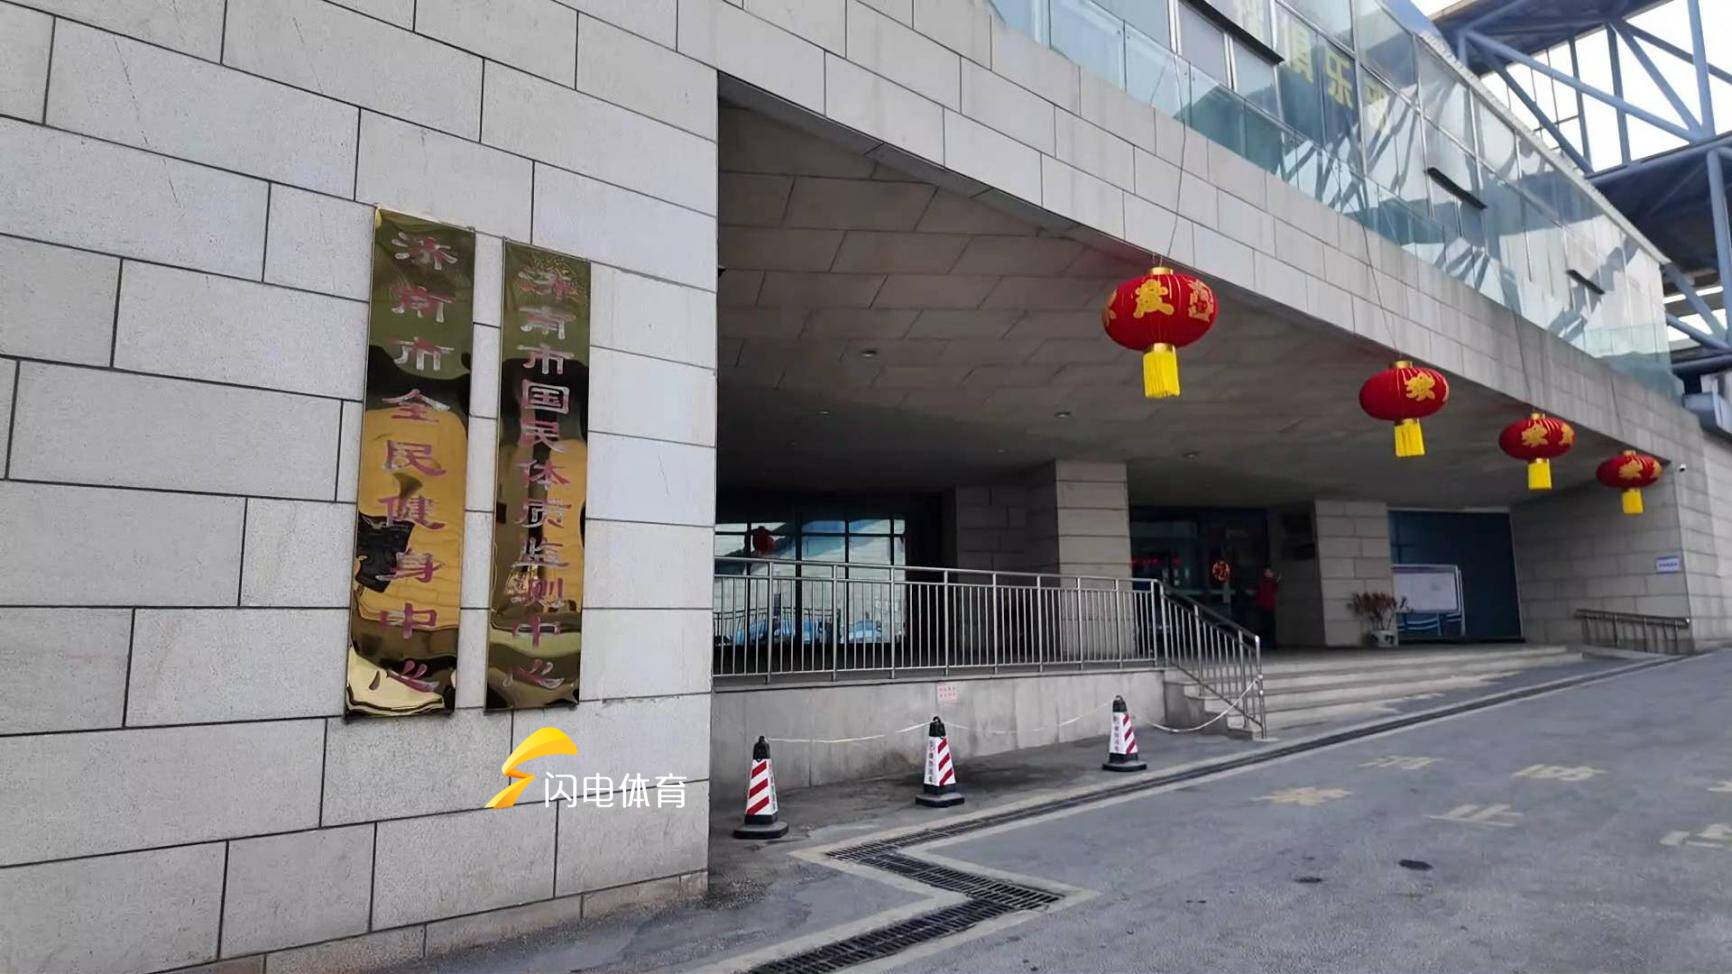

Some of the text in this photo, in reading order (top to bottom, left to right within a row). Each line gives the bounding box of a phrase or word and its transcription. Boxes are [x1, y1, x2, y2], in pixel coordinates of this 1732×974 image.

[368, 231, 459, 692] 济南市全民健身中心
[502, 258, 581, 691] 济南市国民体质监测中心
